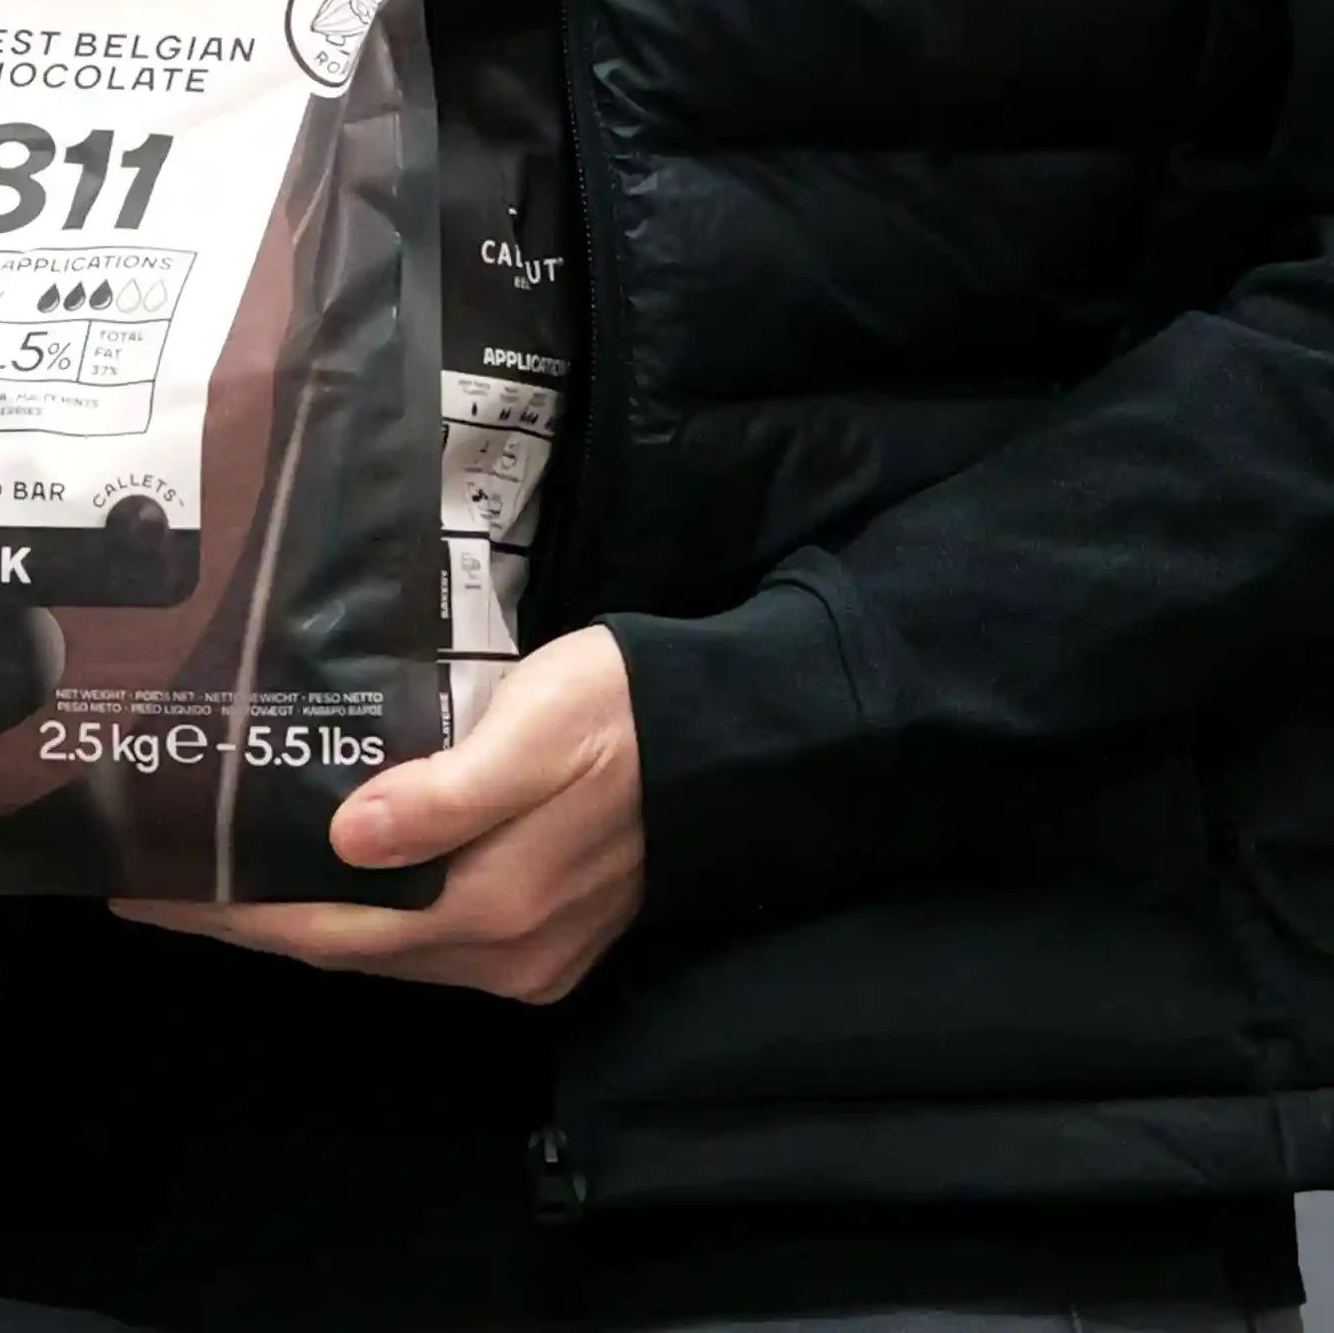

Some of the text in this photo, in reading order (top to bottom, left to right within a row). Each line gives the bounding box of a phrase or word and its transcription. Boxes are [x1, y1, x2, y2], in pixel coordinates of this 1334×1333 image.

[74, 32, 256, 62] BELGIAN
[1, 255, 173, 273] APPLICATIONS
[100, 330, 143, 342] TOTAL
[94, 346, 122, 360] FAT
[13, 482, 66, 501] BAR
[308, 693, 341, 703] PESO
[343, 692, 384, 703] NETTO
